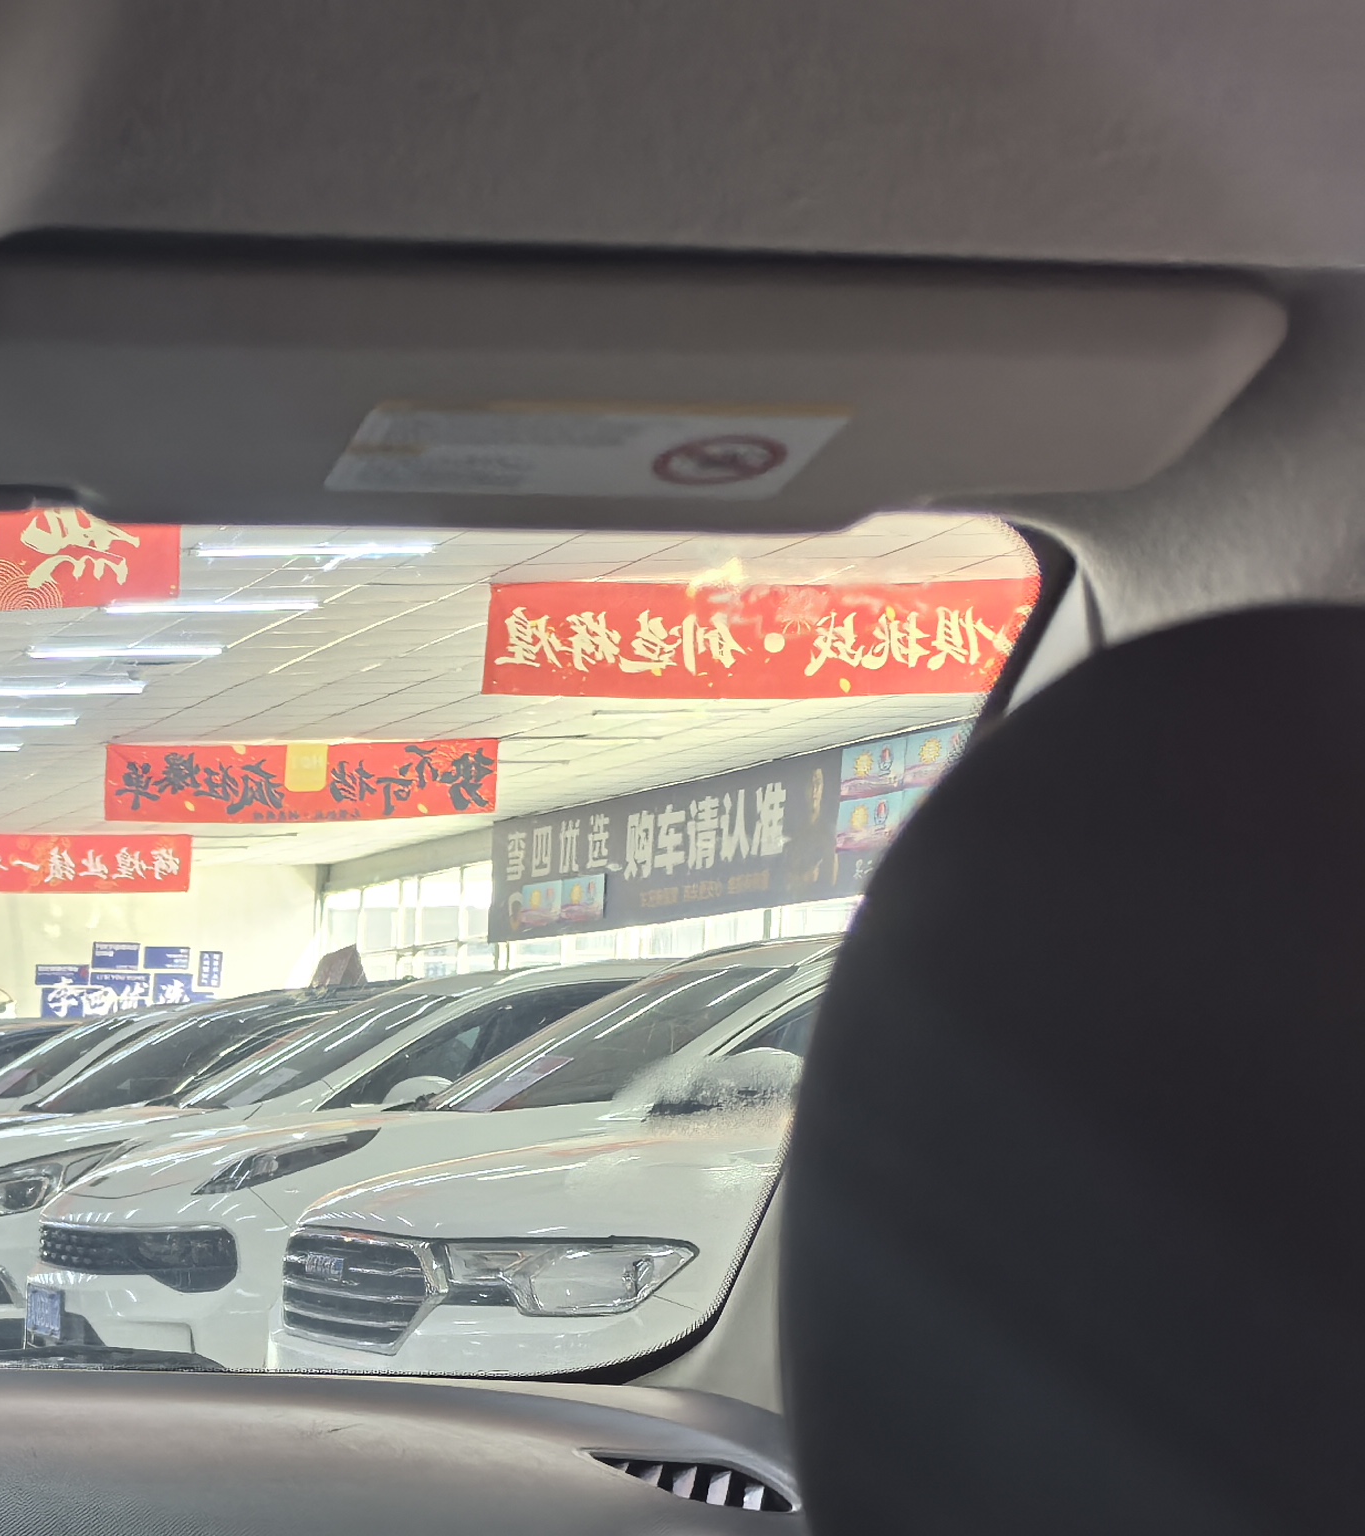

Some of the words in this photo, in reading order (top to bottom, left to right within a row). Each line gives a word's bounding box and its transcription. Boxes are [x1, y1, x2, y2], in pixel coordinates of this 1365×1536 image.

[506, 814, 610, 882] 李四优选
[624, 782, 787, 880] 购车请认准
